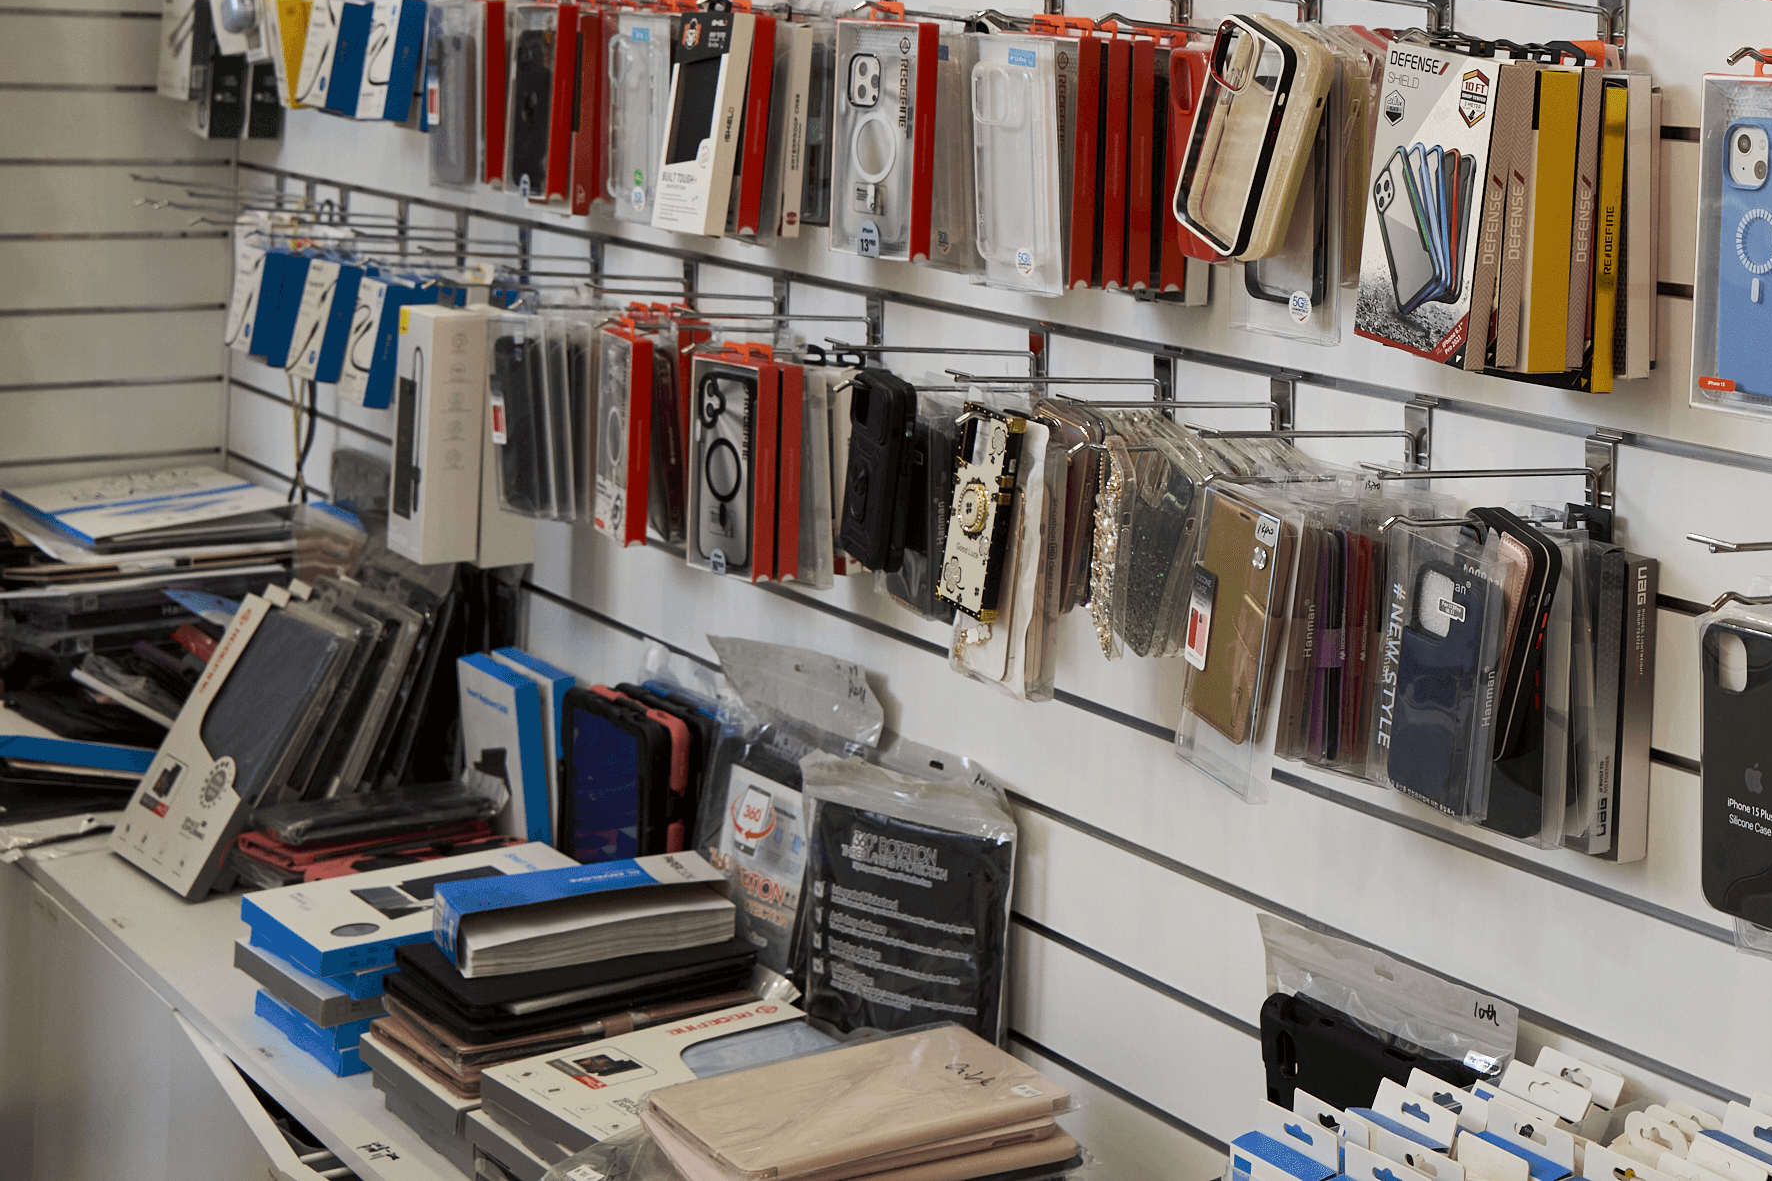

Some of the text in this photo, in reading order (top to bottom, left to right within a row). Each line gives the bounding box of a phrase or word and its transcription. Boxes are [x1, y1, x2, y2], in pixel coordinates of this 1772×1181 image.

[1387, 71, 1420, 89] SHIELD
[1390, 50, 1440, 75] DEFENSE
[1465, 81, 1485, 94] 10 FT
[1483, 191, 1502, 265] DEFENSE
[1509, 185, 1524, 260] DEFENSE
[1576, 190, 1591, 263] DEFENSE
[860, 238, 869, 252] 13
[1293, 295, 1304, 309] 5G
[936, 501, 946, 546] Hanman
[1637, 566, 1648, 605] UAG
[1303, 604, 1316, 658] Hanman
[1387, 603, 1404, 664] NEW
[1377, 670, 1398, 749] STYLE
[1481, 670, 1496, 727] Hanman
[1727, 797, 1751, 814] iPhone
[1751, 805, 1760, 818] 15
[1728, 813, 1772, 837] Silicone Case
[879, 836, 938, 867] ROTATION
